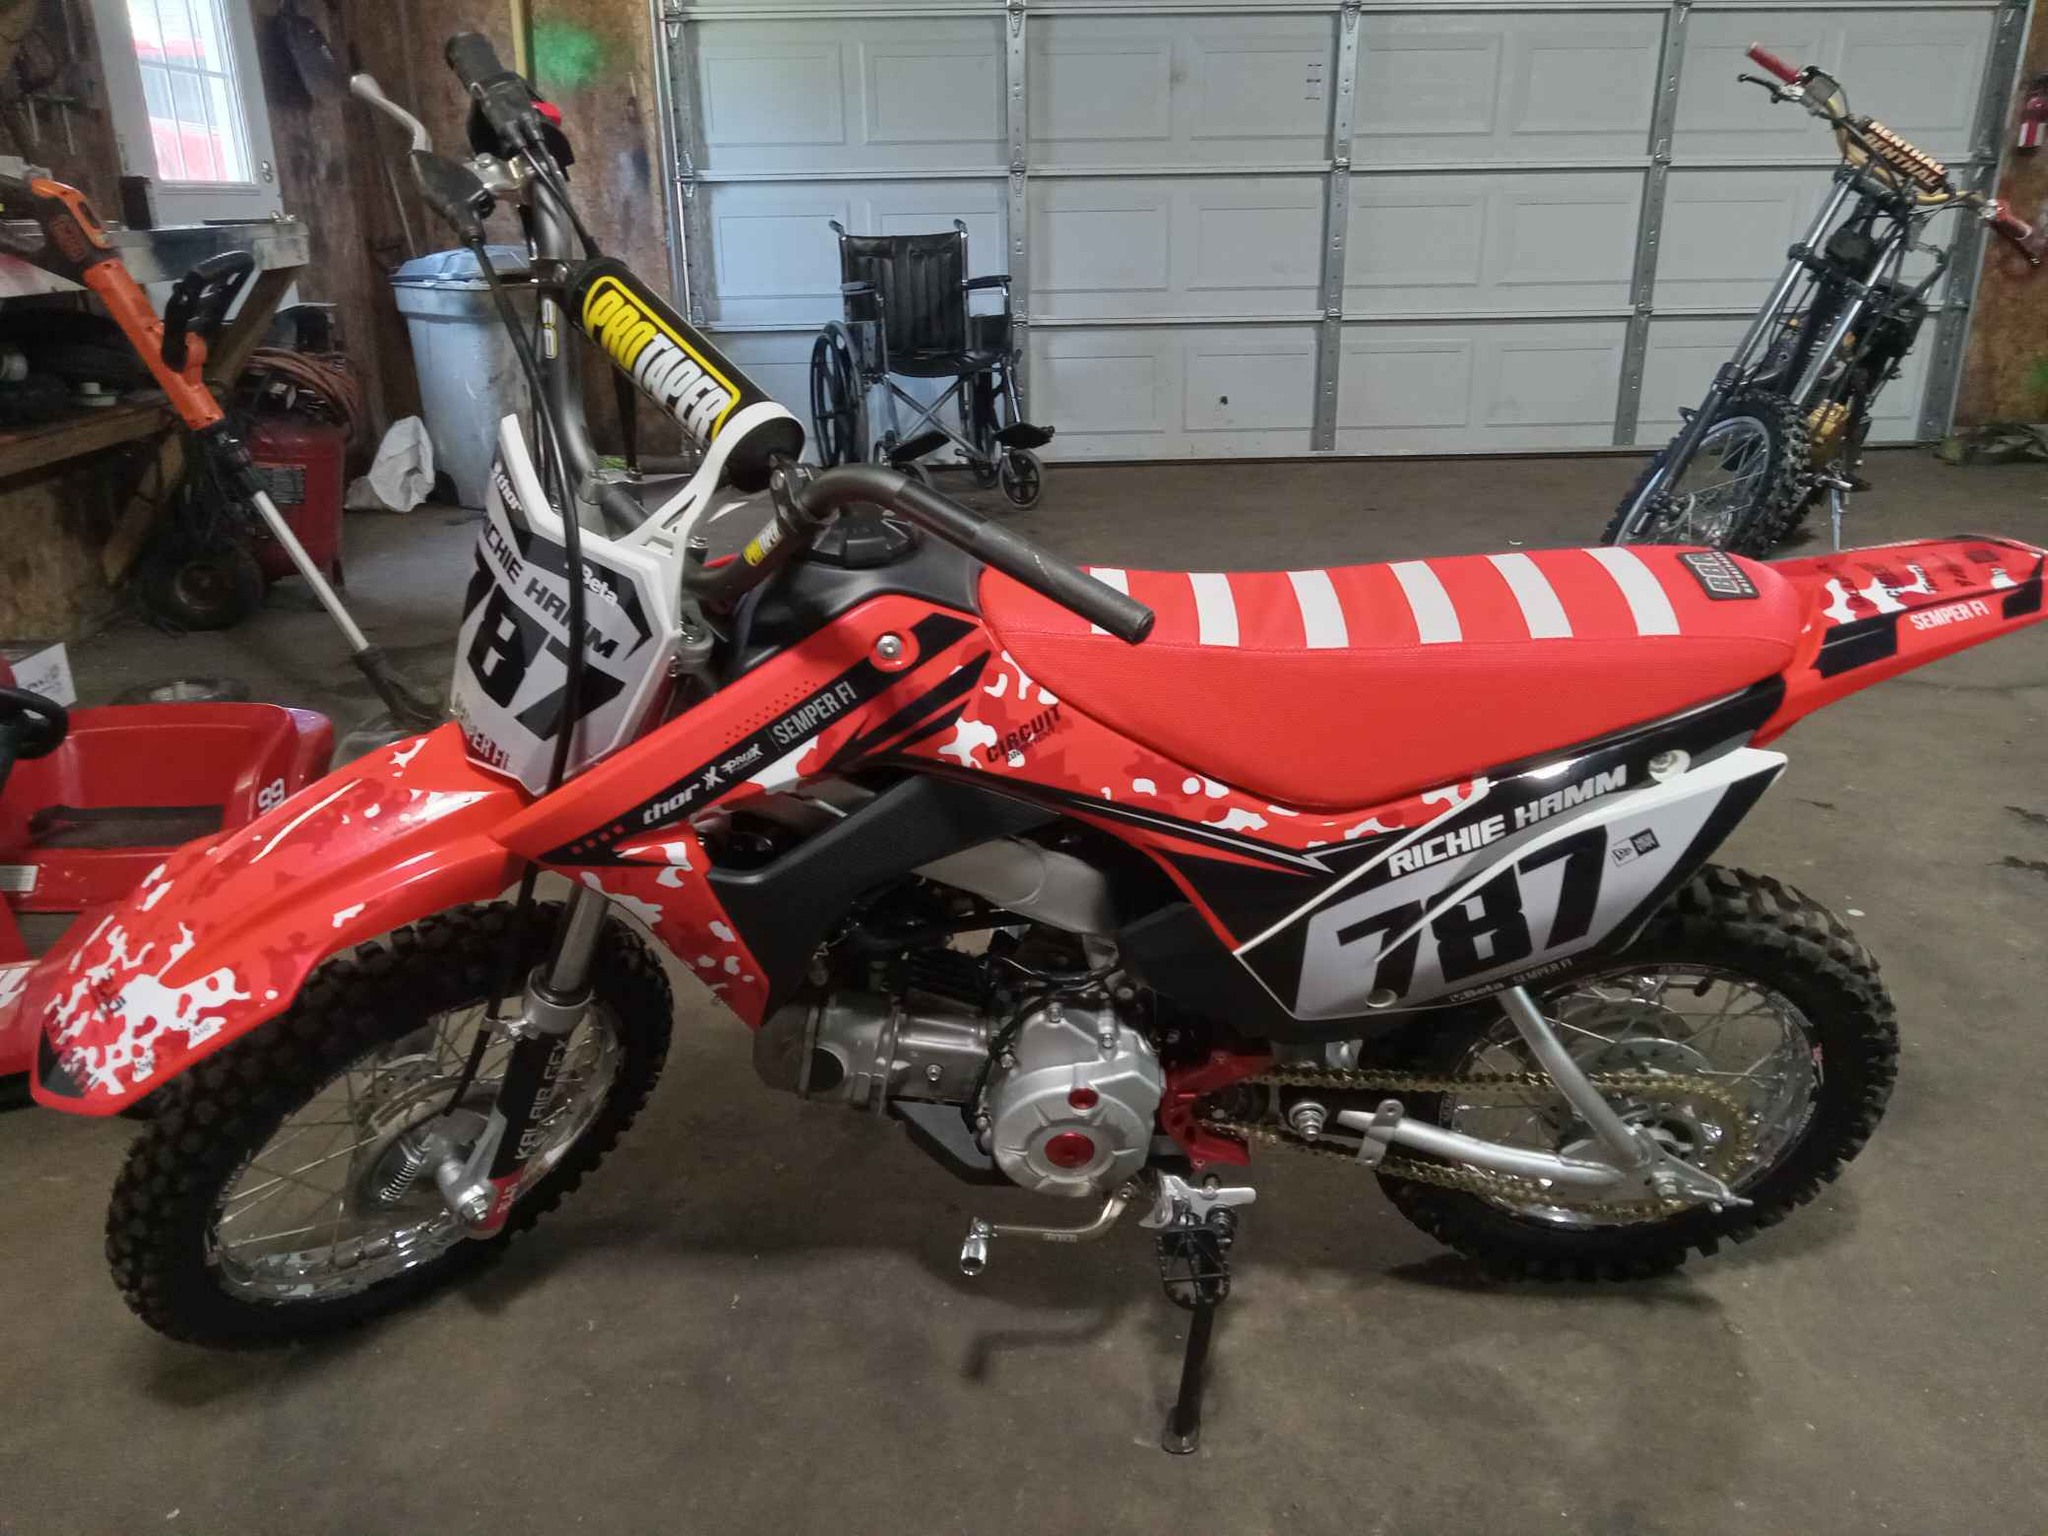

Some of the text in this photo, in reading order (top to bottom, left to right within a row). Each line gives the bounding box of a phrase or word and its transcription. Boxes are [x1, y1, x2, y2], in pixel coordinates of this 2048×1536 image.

[1863, 133, 1939, 187] RENTHAL
[1910, 600, 1990, 631] SEMPER FI
[642, 783, 700, 825] thor
[772, 693, 842, 745] SEMPER
[836, 680, 858, 705] FI
[985, 704, 1062, 763] CIRCUIT
[1388, 764, 1627, 878] RICHIE HAMM
[1337, 824, 1608, 998] 787
